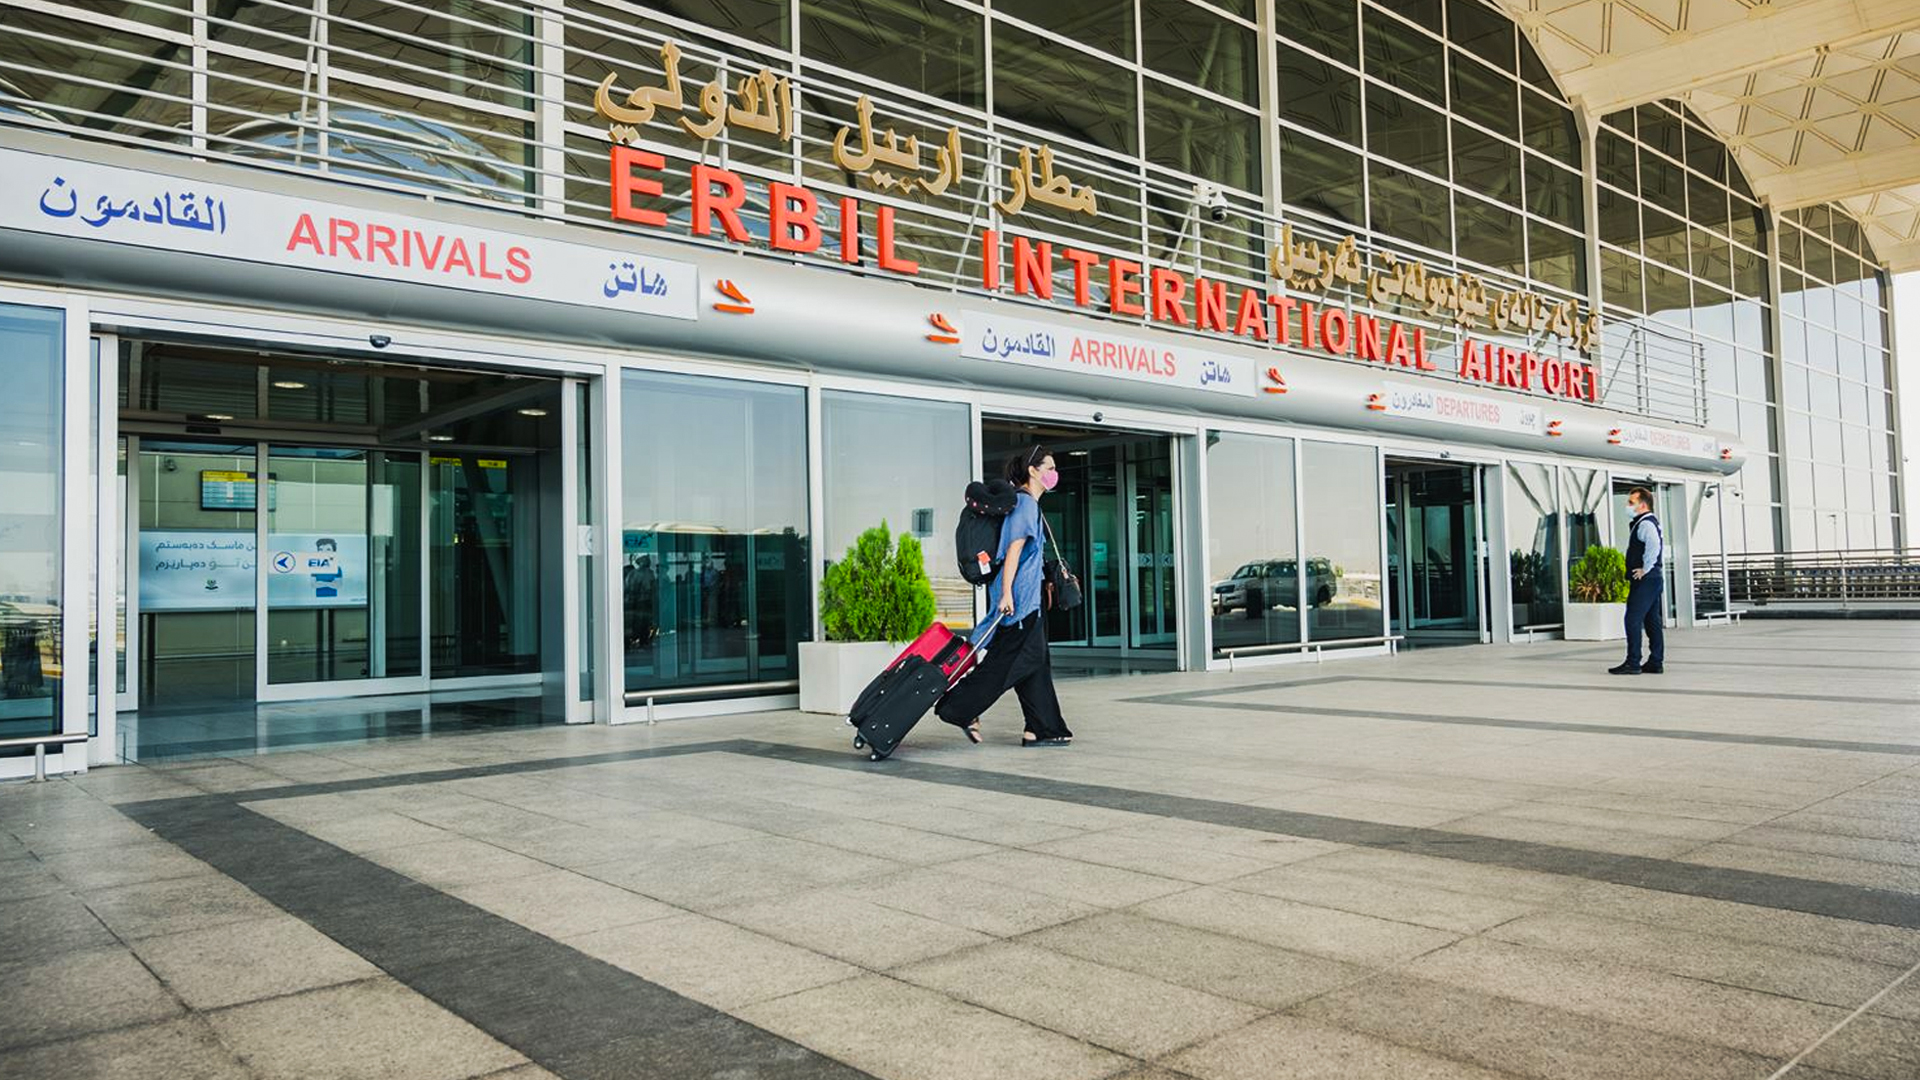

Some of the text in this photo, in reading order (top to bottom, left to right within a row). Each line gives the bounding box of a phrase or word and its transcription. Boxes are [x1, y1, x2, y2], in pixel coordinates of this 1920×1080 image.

[993, 144, 1098, 217] مطار
[39, 176, 226, 235] القادمون
[286, 212, 533, 284] ARRIVALS
[603, 262, 668, 298] هاتن
[610, 145, 1600, 403] ERBIL INTERNATIONAL AIRPORT
[982, 327, 1056, 359] القادمون
[1070, 337, 1177, 377] ARRIVALS
[1200, 360, 1231, 385] هاتن
[1436, 396, 1500, 424] DEPARTURES
[308, 558, 330, 568] EIA
